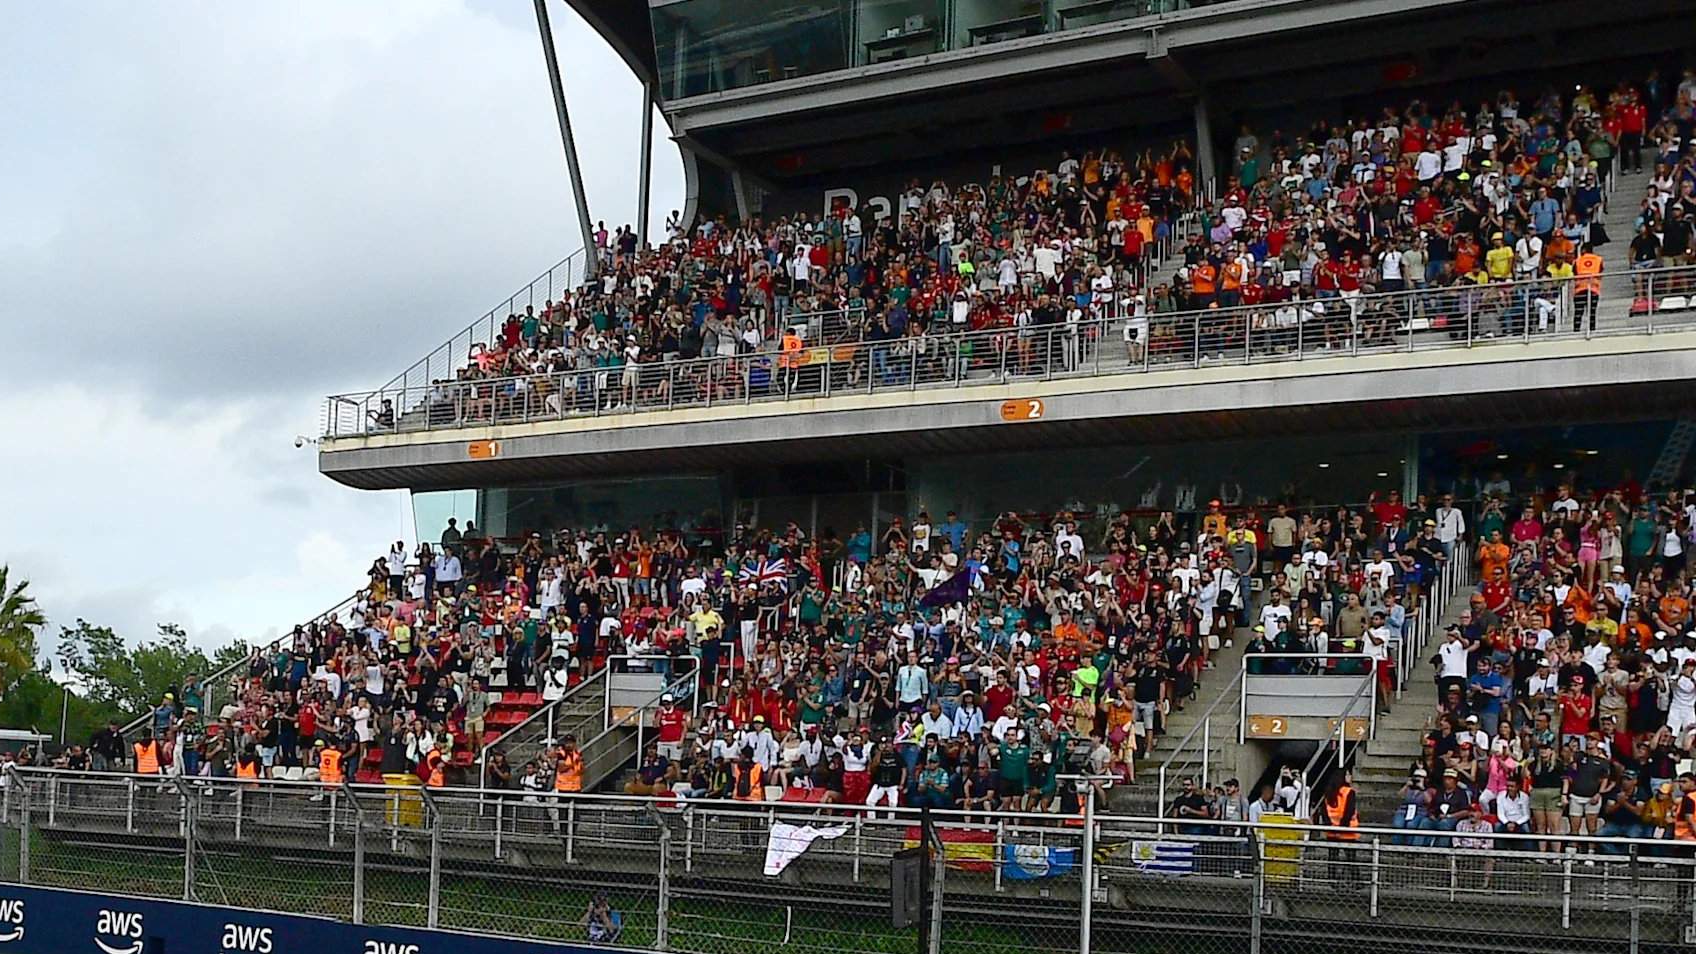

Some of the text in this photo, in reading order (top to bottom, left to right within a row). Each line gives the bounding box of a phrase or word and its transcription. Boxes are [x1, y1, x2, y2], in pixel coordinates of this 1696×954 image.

[1028, 401, 1041, 418] 2
[488, 441, 496, 456] 1
[1271, 719, 1283, 734] 2
[97, 910, 144, 938] aws
[222, 923, 273, 954] aws
